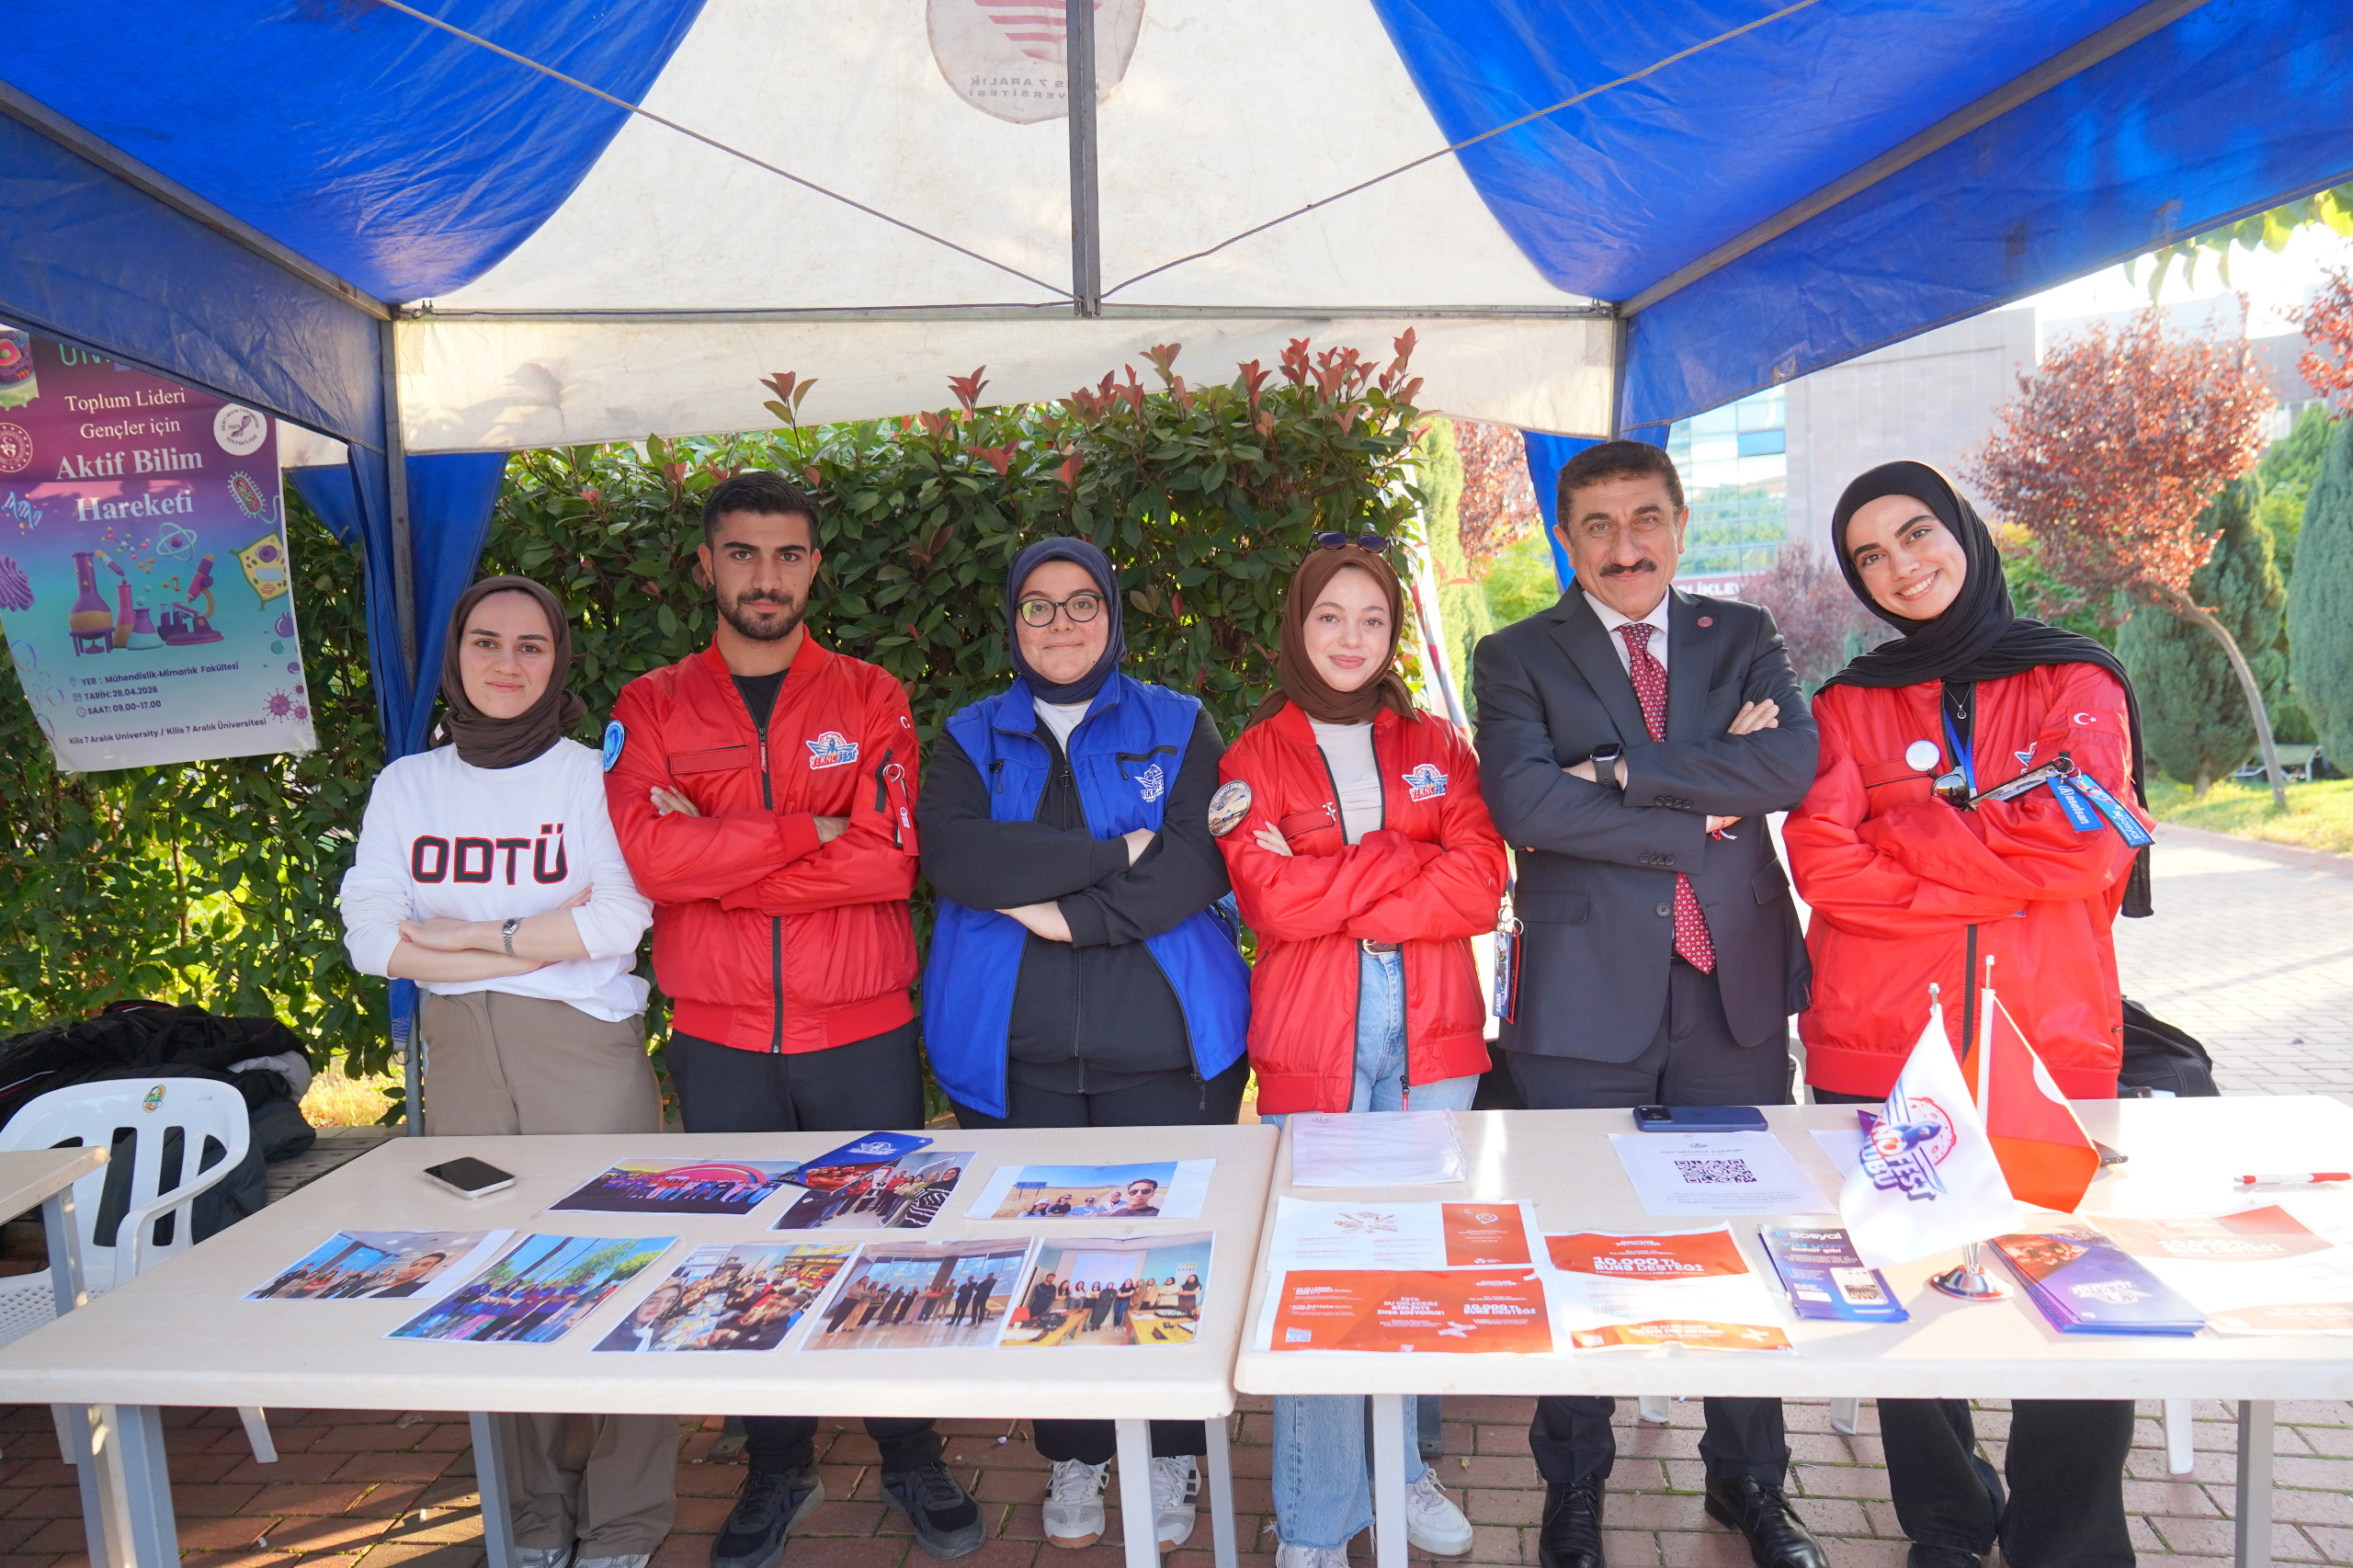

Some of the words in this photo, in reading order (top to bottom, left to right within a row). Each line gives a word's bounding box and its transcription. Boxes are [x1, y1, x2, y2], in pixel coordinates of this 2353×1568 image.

[64, 393, 131, 414] Toplum
[135, 388, 186, 407] Lideri
[80, 420, 145, 439] Gençler
[148, 418, 181, 436] için
[56, 451, 126, 480] Aktif
[131, 447, 203, 473] Bilim
[74, 489, 195, 521] Hareketi
[81, 677, 97, 686] YER
[200, 662, 239, 674] Fakültesi
[85, 689, 112, 700] TARİH:
[112, 686, 158, 698] 28.04.2026
[87, 705, 112, 715] SAAT:
[112, 700, 162, 712] 09.00-17.00
[69, 736, 84, 744] Kilis
[90, 733, 114, 743] Aralık
[115, 729, 159, 740] University
[165, 726, 185, 735] Kilis
[192, 722, 216, 733] Aralık
[217, 717, 267, 730] Üniversitesi
[2065, 794, 2090, 825] aselsan
[411, 823, 568, 885] ODTÜ
